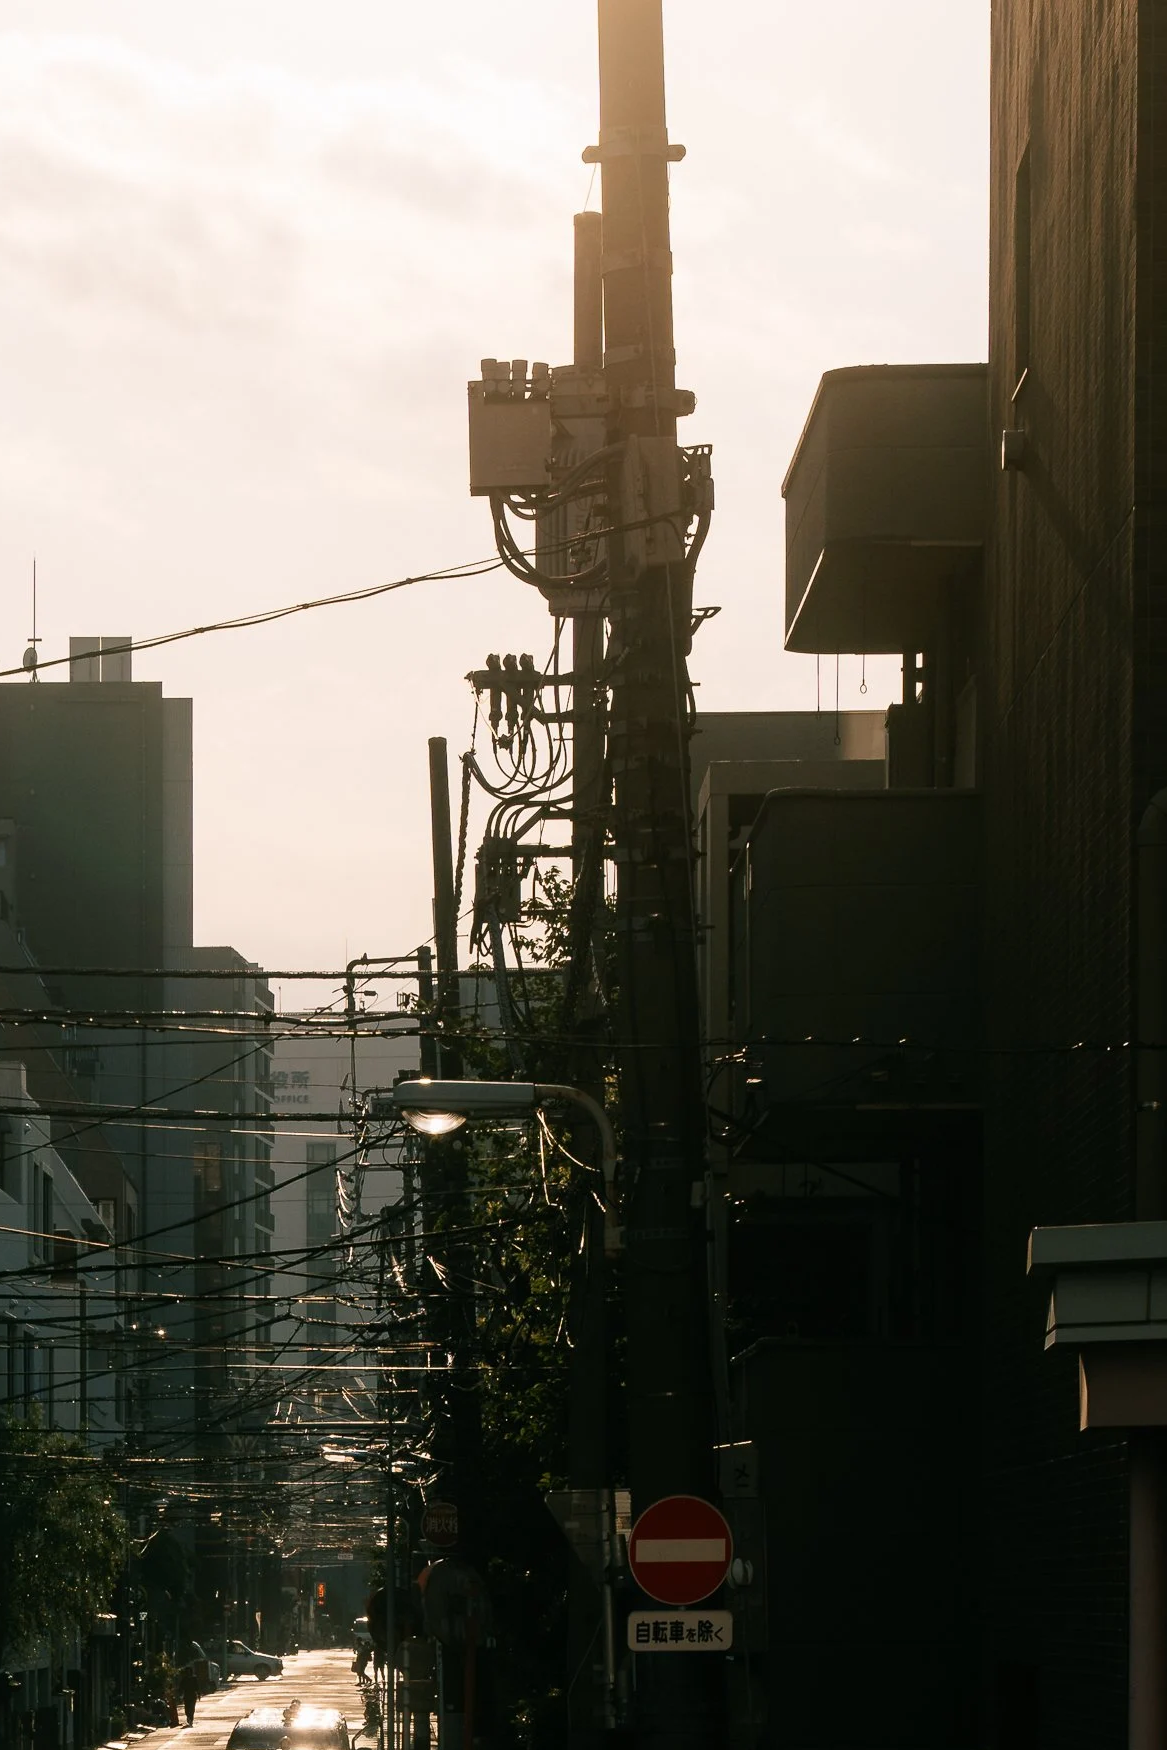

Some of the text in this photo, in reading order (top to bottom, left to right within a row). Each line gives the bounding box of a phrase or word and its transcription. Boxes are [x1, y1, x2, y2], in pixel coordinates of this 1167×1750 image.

[635, 1619, 725, 1644] 自転車を除く
